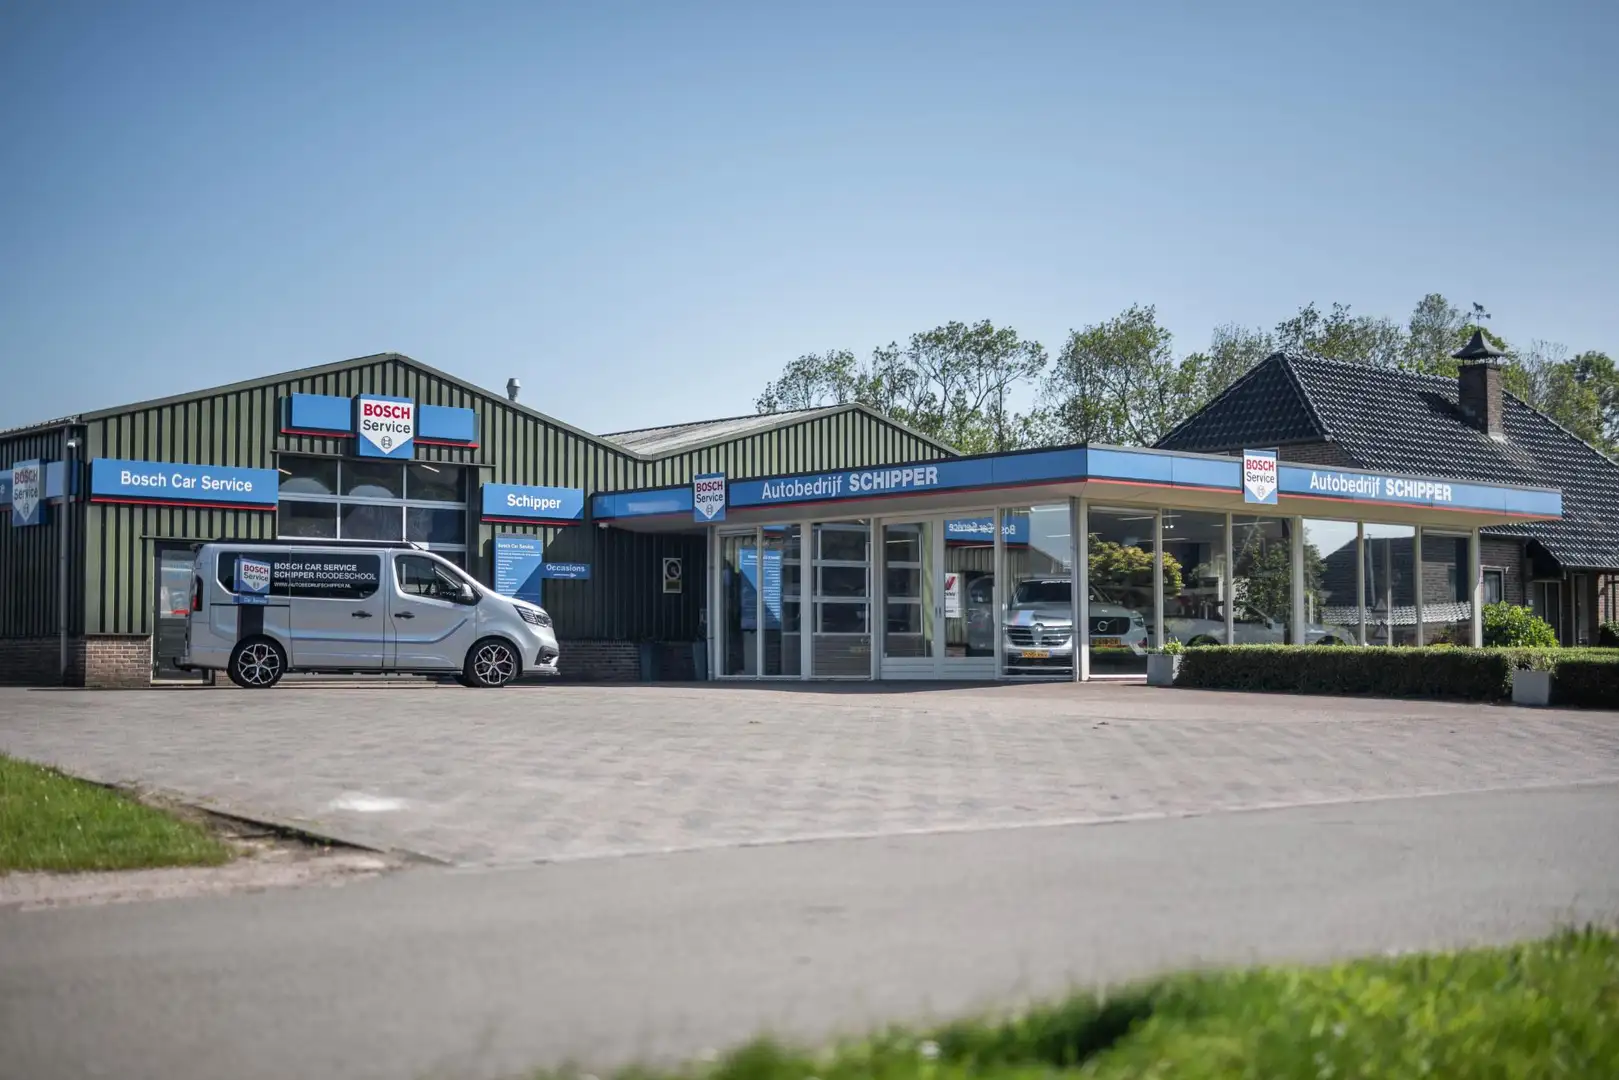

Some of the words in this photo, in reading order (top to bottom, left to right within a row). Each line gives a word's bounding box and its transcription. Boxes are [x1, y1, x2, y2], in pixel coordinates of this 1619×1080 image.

[363, 403, 411, 420] BOSCH
[363, 419, 411, 434] Service
[1246, 459, 1275, 471] BOSCH
[15, 468, 39, 485] BOSCH
[121, 470, 167, 487] Bosch
[171, 474, 197, 489] Car
[201, 476, 253, 492] Service
[1246, 471, 1275, 483] Service
[696, 480, 723, 492] BOSCH
[761, 476, 842, 500] Autobedrijf
[849, 466, 938, 492] SCHIPPER
[1310, 472, 1381, 497] Autobedrijf
[1385, 479, 1453, 501] SCHIPPER
[14, 485, 39, 500] Service
[696, 492, 723, 503] Service
[507, 493, 561, 511] Schipper
[243, 564, 269, 575] BOSCH
[274, 562, 303, 570] BOSCH
[305, 563, 322, 571] CAR
[546, 564, 585, 572] Occasions
[243, 572, 269, 581] Service
[274, 571, 315, 579] SCHIPPER
[316, 572, 376, 580] ROODESCHOOL
